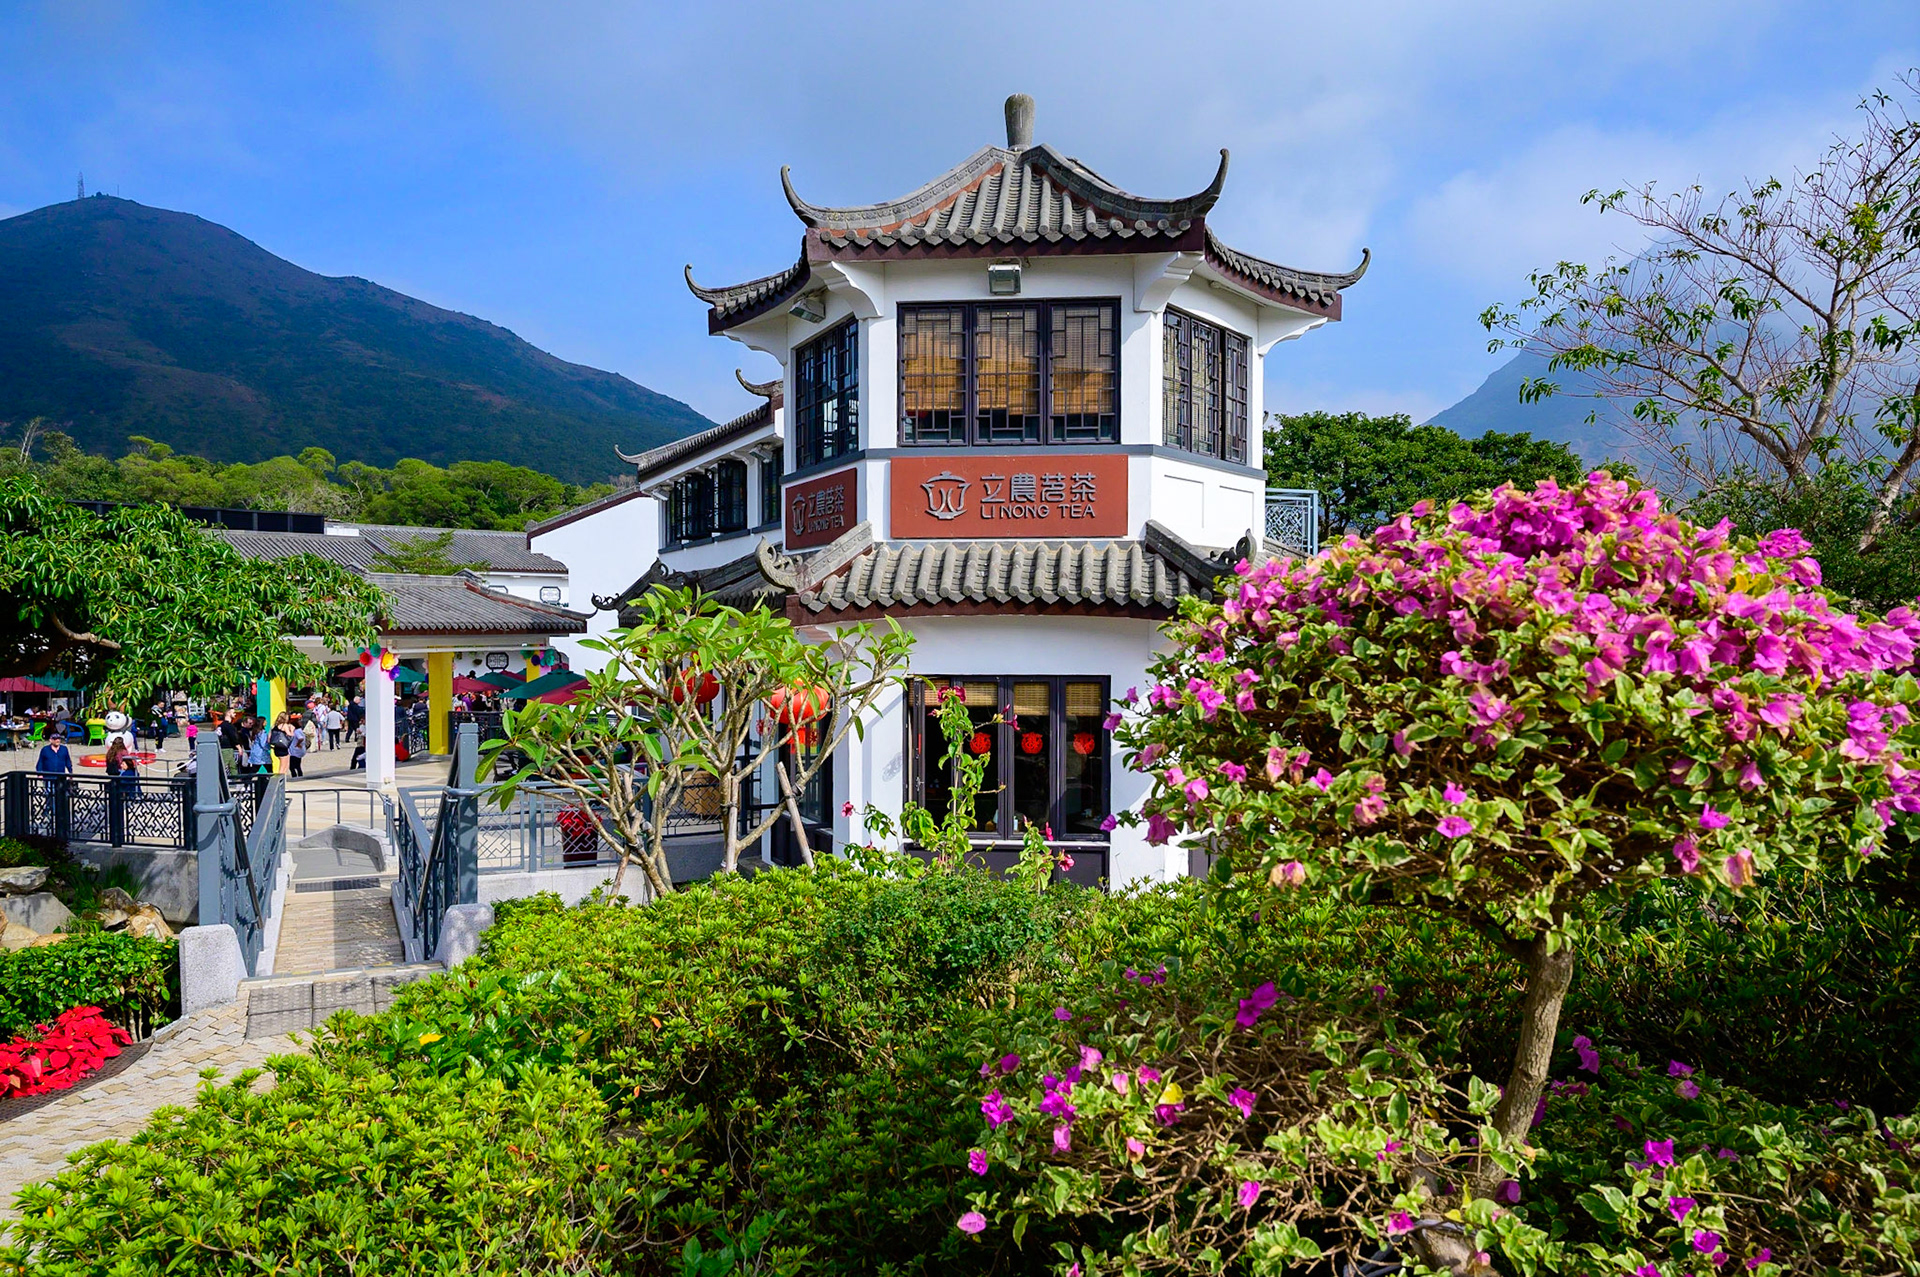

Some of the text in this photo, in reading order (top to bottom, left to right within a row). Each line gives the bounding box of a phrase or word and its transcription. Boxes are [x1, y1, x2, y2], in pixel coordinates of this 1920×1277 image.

[981, 472, 1096, 502] 立農茗茶
[981, 503, 1096, 519] LI NONG TEA
[830, 514, 845, 528] TEA
